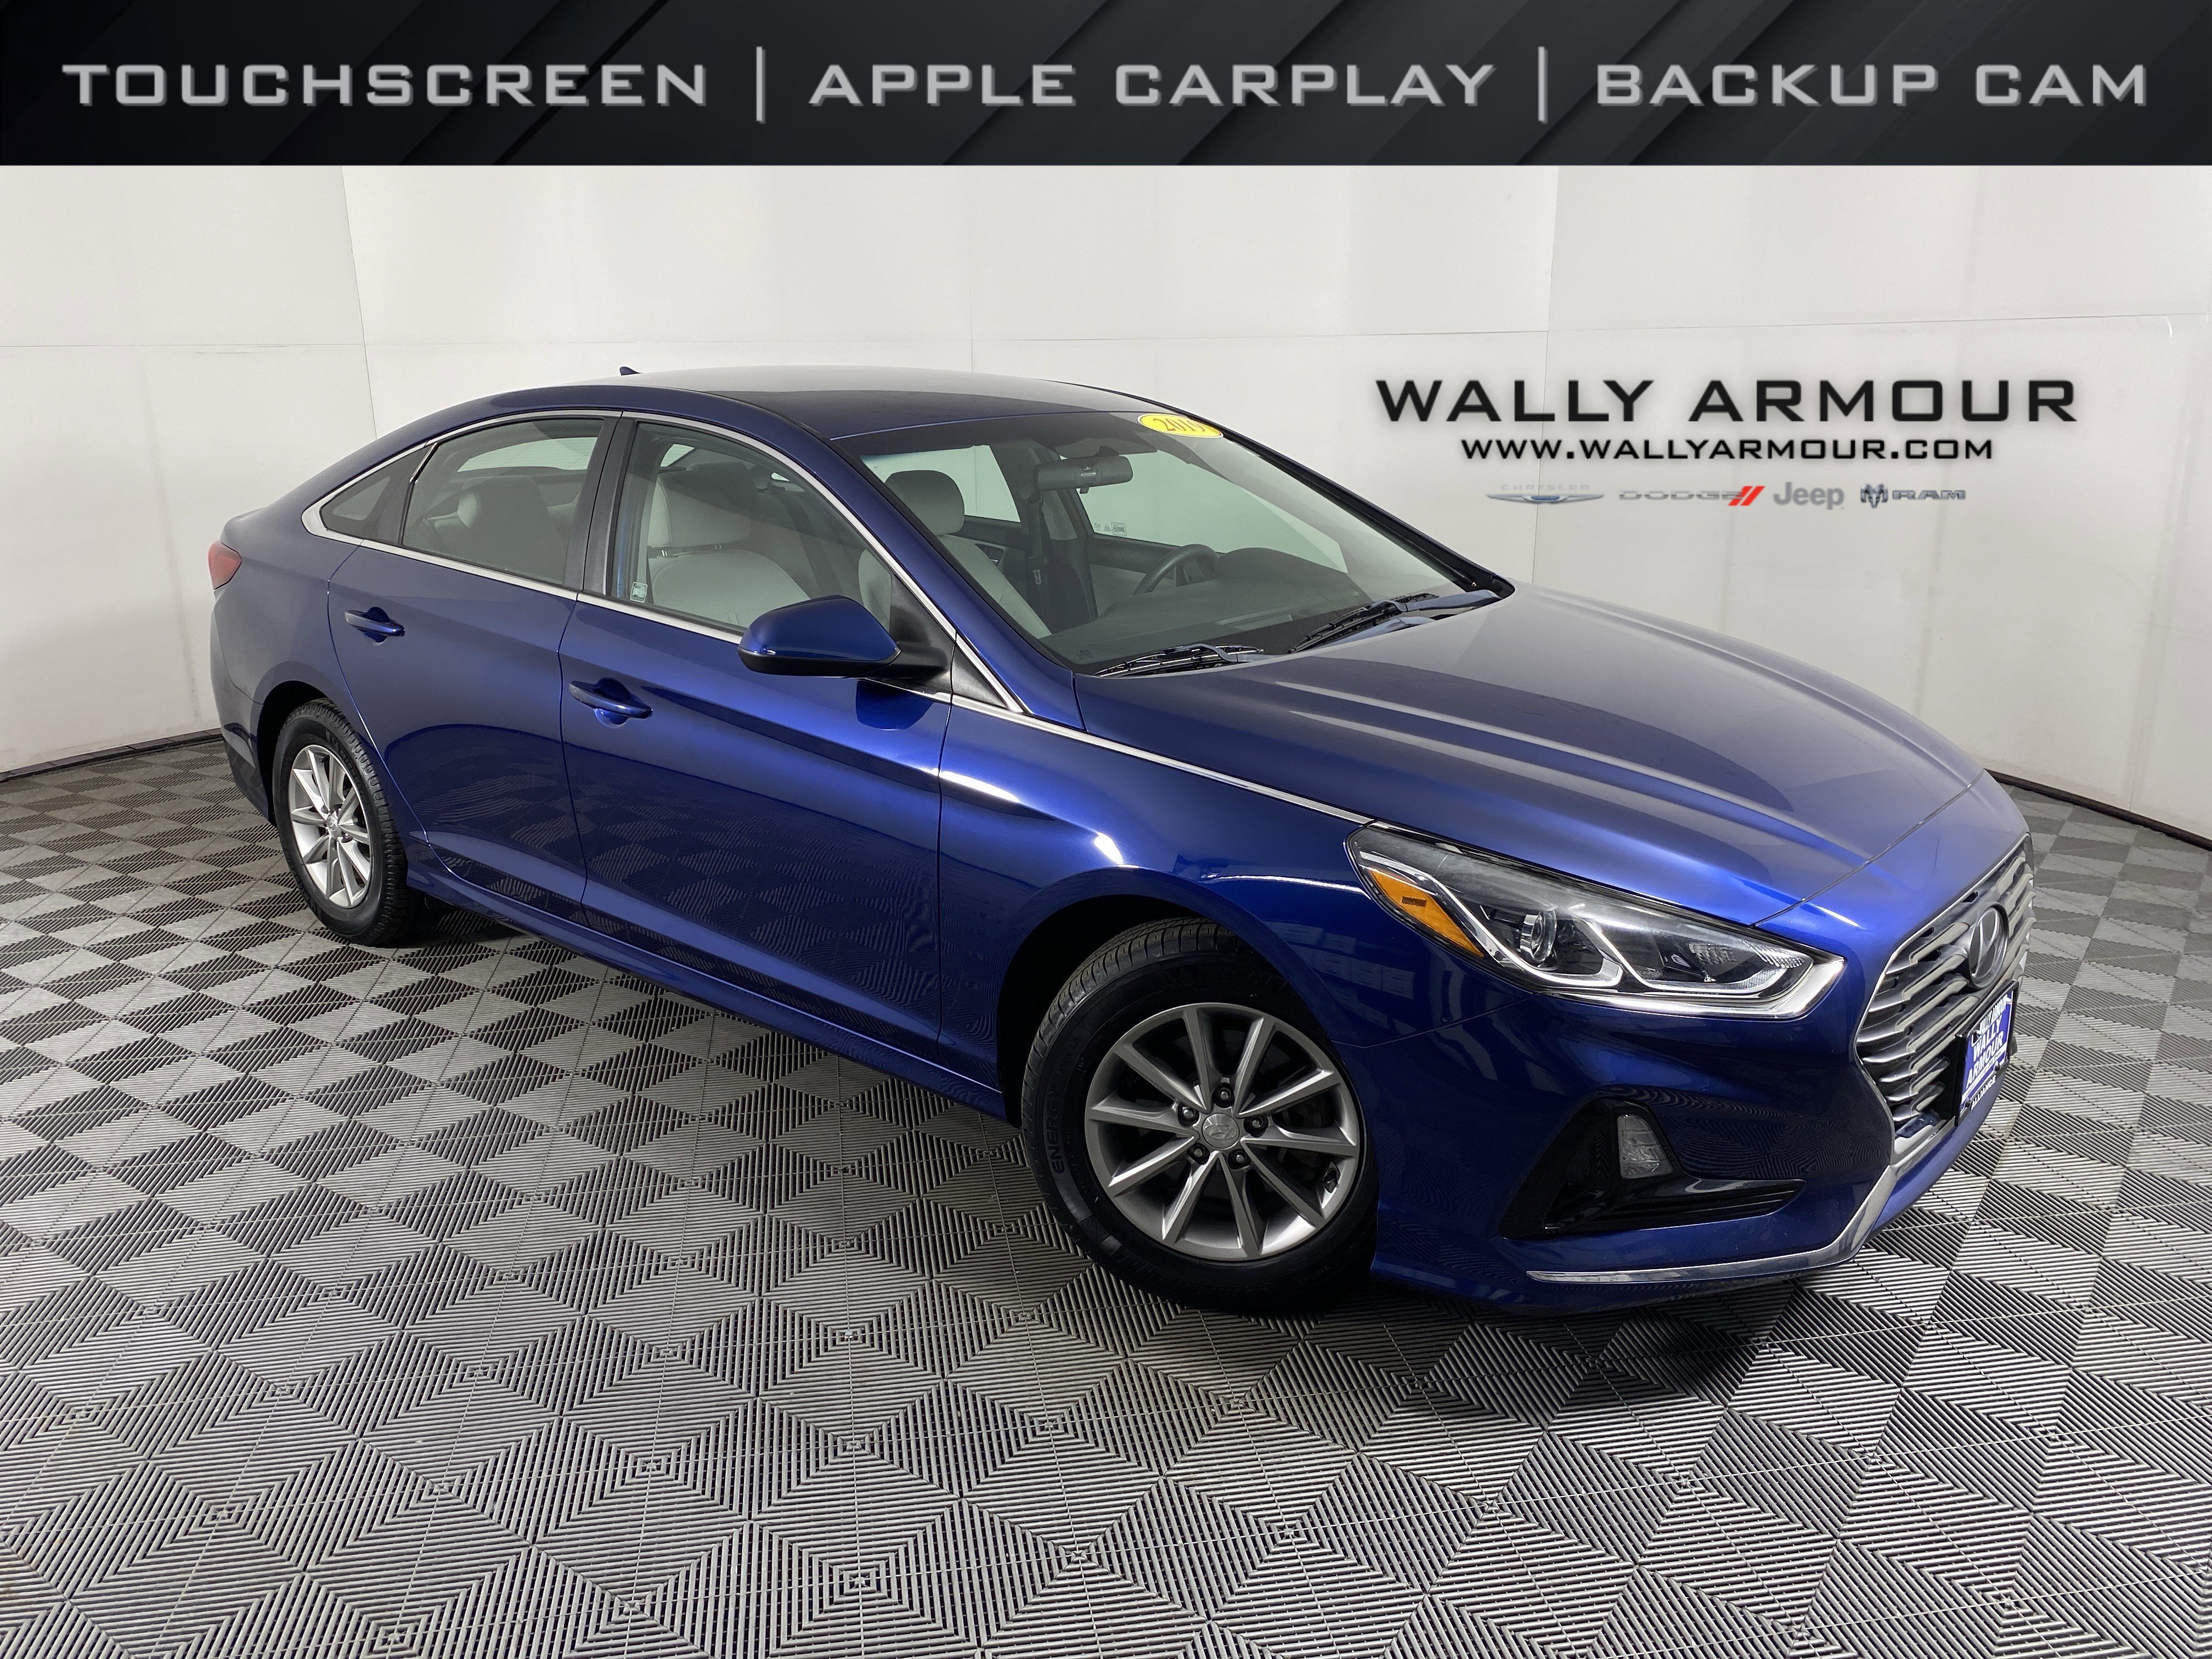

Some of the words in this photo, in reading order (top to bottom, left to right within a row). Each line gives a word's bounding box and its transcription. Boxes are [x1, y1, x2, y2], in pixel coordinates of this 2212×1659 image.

[1153, 417, 1206, 433] 2019
[1966, 1030, 2004, 1090] ARMOUR
[1973, 1014, 2002, 1063] WALLY
[1971, 1074, 1996, 1111] ALLIANCE
